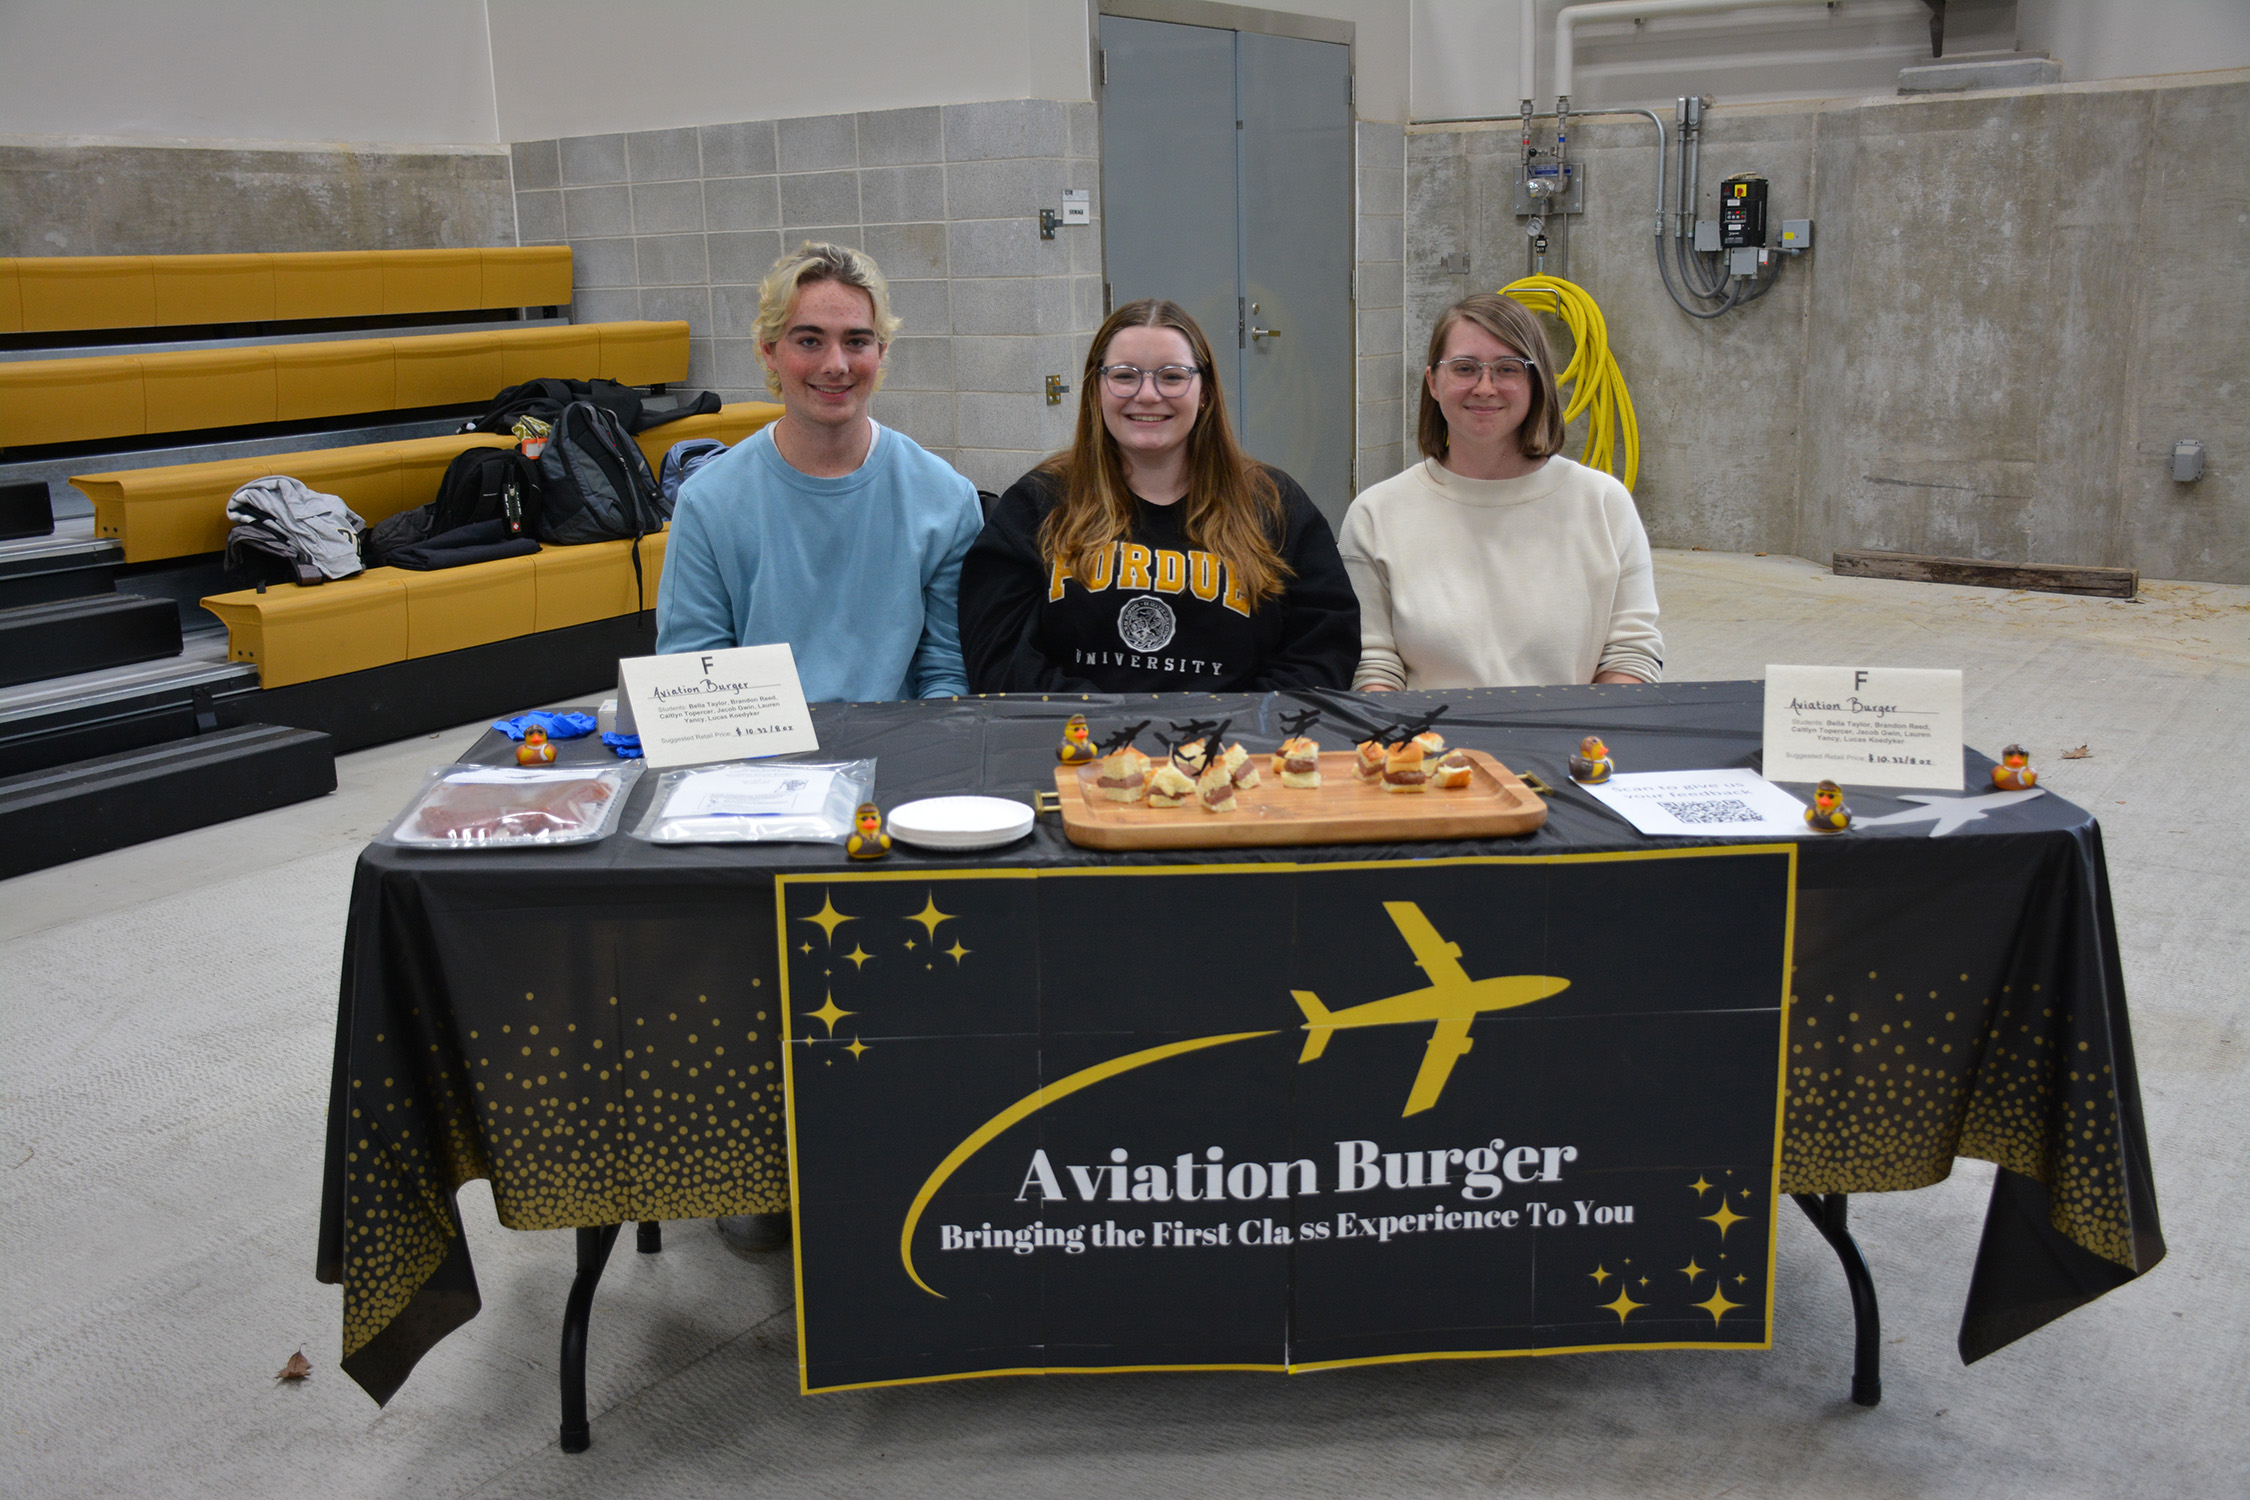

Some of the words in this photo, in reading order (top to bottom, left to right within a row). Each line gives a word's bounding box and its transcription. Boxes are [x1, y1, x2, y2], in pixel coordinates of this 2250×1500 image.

[701, 656, 714, 675] F
[654, 685, 700, 702] Aviation
[700, 679, 749, 695] Burger
[1854, 671, 1868, 691] F
[729, 711, 760, 719] Koedyker
[1790, 698, 1841, 715] Aviation
[1846, 697, 1897, 718] Burger
[661, 736, 694, 744] Suggested
[1670, 789, 1752, 798] feedback
[1014, 1146, 1320, 1201] Aviation
[1334, 1138, 1578, 1200] Burger
[940, 1222, 1086, 1254] Bringing
[1092, 1220, 1146, 1247] the
[1152, 1220, 1232, 1247] First
[1336, 1204, 1520, 1242] Experience
[1526, 1202, 1566, 1226] To
[1573, 1200, 1634, 1226] You
